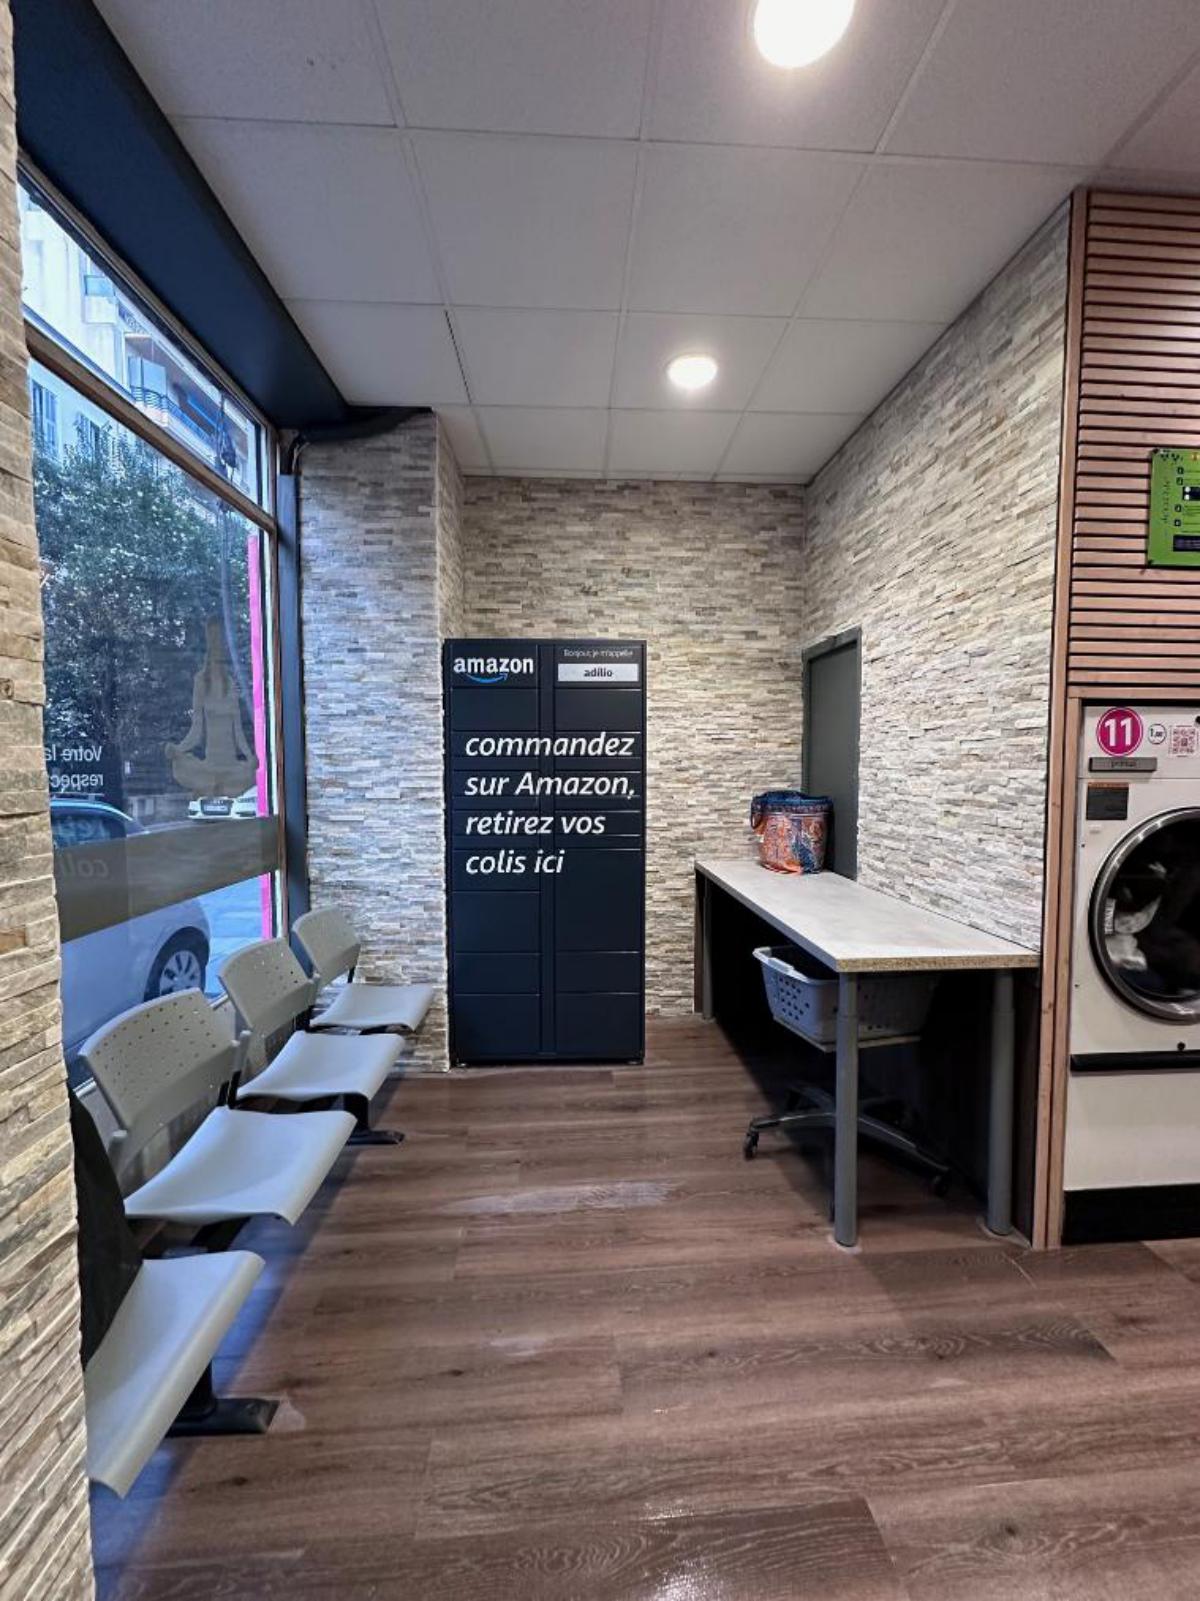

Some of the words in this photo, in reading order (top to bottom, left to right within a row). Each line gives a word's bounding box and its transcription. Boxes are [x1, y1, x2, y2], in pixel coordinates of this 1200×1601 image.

[453, 657, 534, 675] amazon
[583, 667, 614, 677] adilio
[465, 732, 635, 756] commandez
[1104, 717, 1133, 747] 11
[464, 777, 510, 796] sur
[514, 772, 635, 799] Amazon,
[465, 810, 554, 835] retirez
[561, 815, 606, 834] vos
[465, 849, 527, 874] colis
[533, 849, 565, 873] ici
